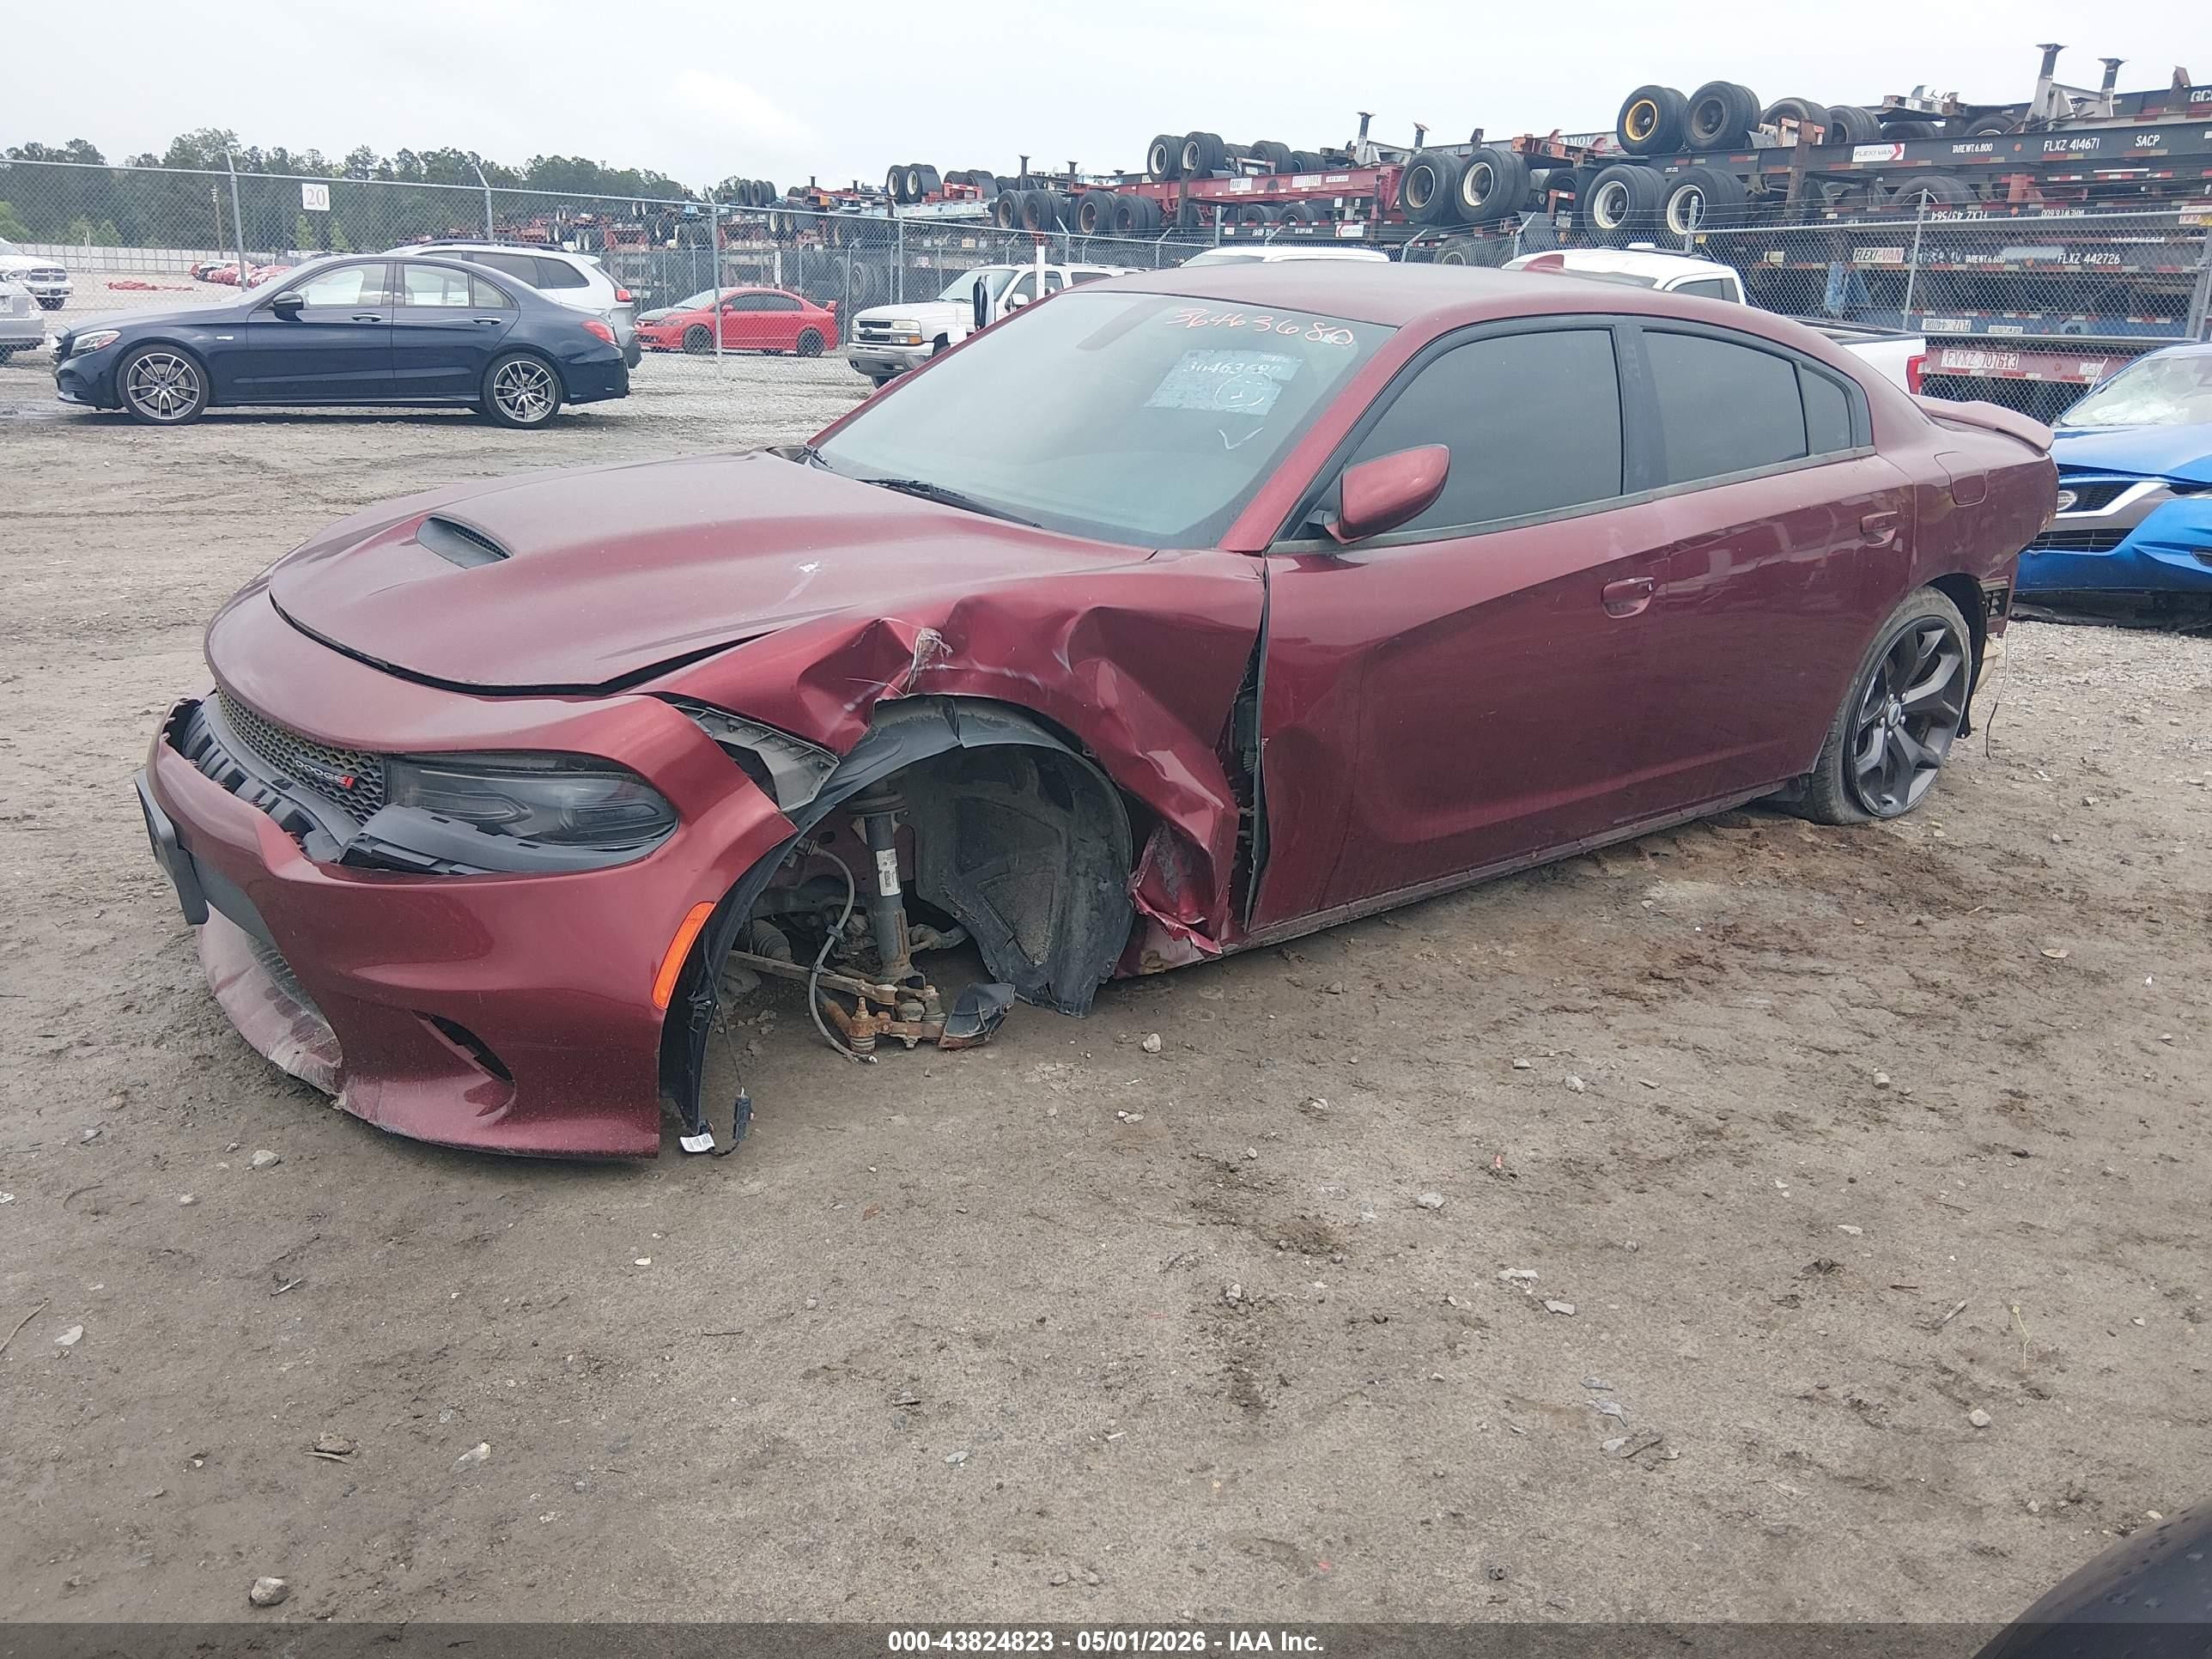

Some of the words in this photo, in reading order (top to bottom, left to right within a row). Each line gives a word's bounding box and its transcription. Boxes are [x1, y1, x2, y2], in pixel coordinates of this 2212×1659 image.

[2191, 89, 2212, 102] GC
[1569, 136, 1594, 146] MOL
[2044, 139, 2068, 152] FLXZ
[2069, 137, 2100, 151] 414671
[2135, 135, 2160, 148] SACP
[307, 188, 326, 206] 20
[2057, 252, 2081, 264] FLXZ
[2083, 252, 2120, 264] 442726
[1164, 307, 1354, 345] 36463680
[1946, 350, 1976, 367] FVXZ
[1982, 352, 2018, 369] 707613
[295, 759, 347, 785] DODGE
